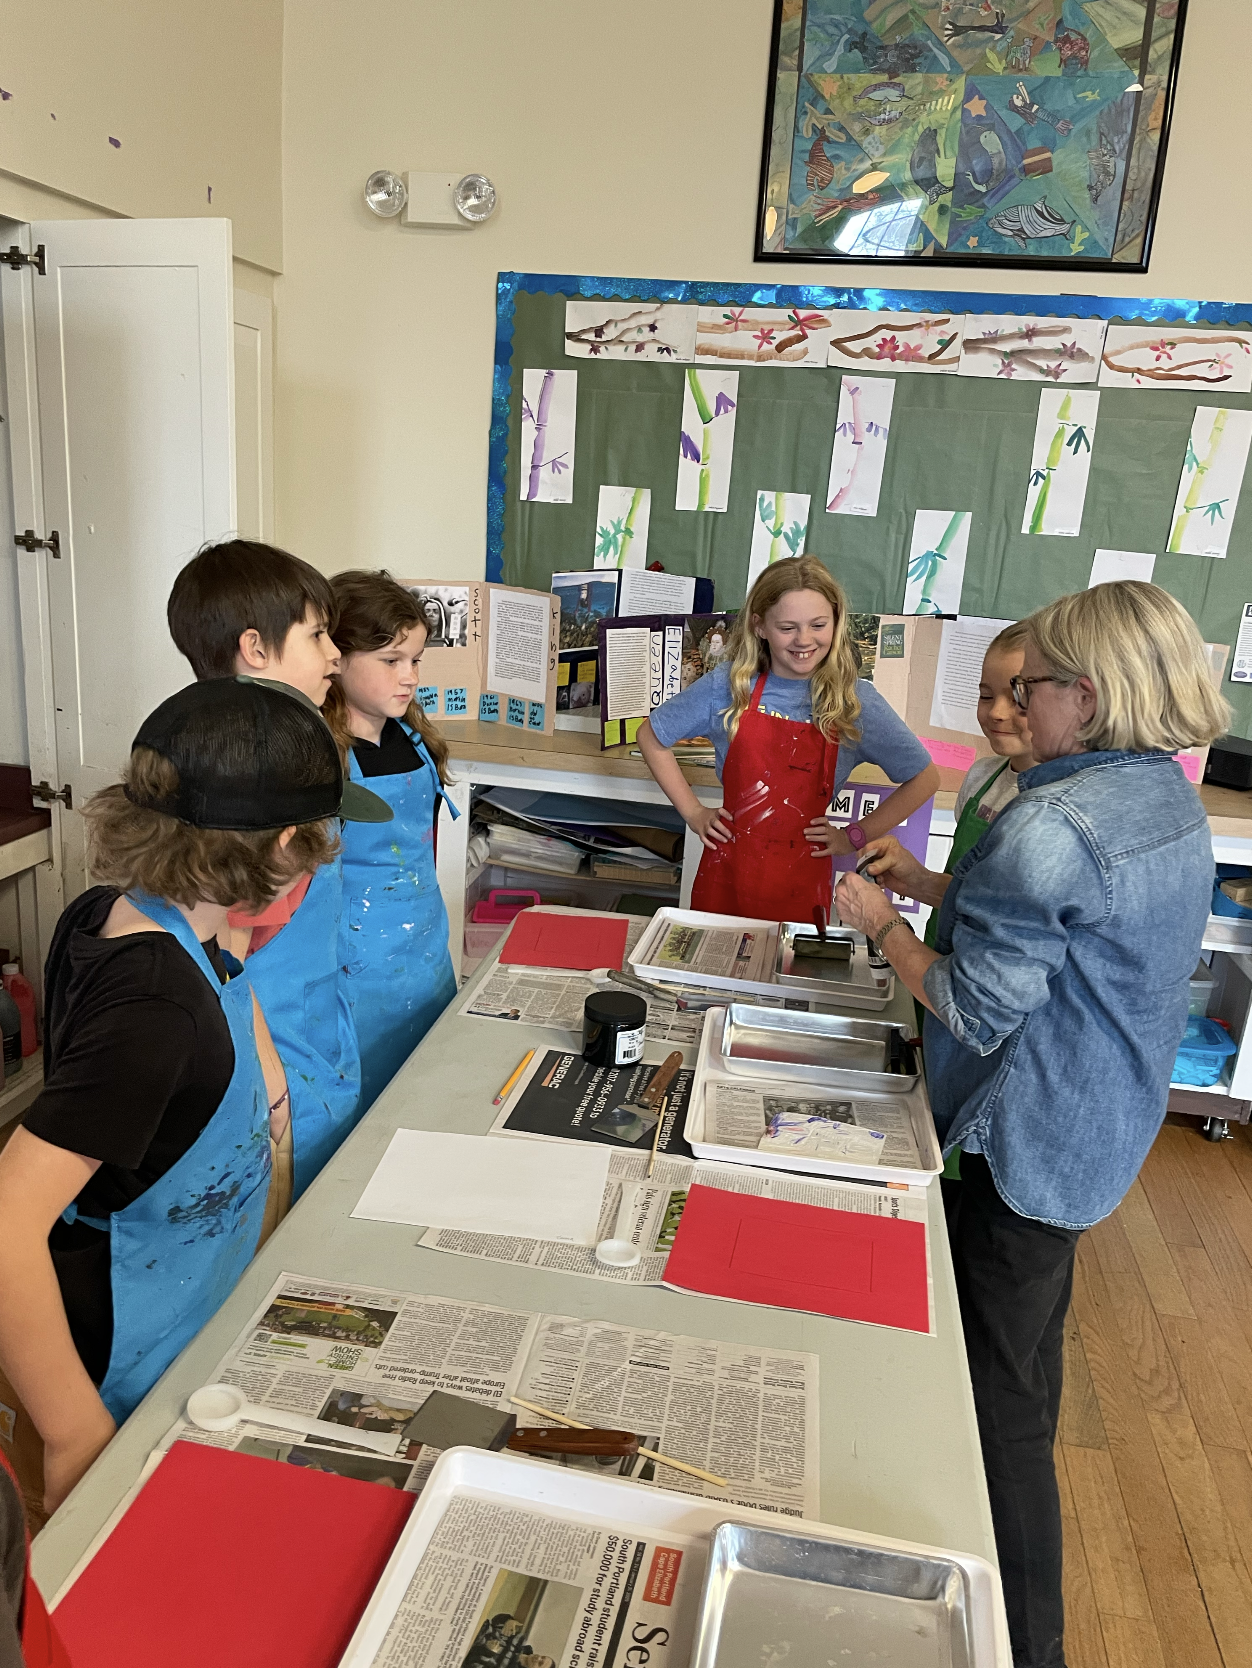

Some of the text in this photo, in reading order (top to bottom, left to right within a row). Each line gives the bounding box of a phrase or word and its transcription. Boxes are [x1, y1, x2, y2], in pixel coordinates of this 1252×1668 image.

[549, 1055, 575, 1089] GENERAC
[679, 1071, 694, 1081] It's
[586, 1082, 598, 1095] your
[592, 1071, 619, 1112] 207-956-0933
[675, 1080, 687, 1092] not
[580, 1094, 594, 1107] free
[671, 1091, 687, 1106] just
[571, 1106, 586, 1126] quote!
[656, 1111, 678, 1150] generator.
[330, 1345, 363, 1356] SHOW
[327, 1353, 360, 1362] ENERGY
[334, 1358, 357, 1366] HOME
[326, 1363, 354, 1372] GREEN
[373, 1363, 506, 1389] Europe afloat after Trump-ordered cuts
[382, 1373, 397, 1381] Free
[398, 1375, 418, 1385] Radio
[419, 1377, 436, 1387] keep
[445, 1382, 463, 1391] ways
[465, 1385, 492, 1396] debates
[493, 1389, 503, 1398] EU
[758, 1503, 778, 1513] rules
[780, 1507, 804, 1519] Judge
[600, 1534, 619, 1572] $50,000
[596, 1572, 608, 1587] for
[650, 1552, 668, 1598] Cape Elizabeth
[659, 1552, 678, 1602] South Portland
[584, 1587, 601, 1616] study
[586, 1538, 633, 1668] South Portland student rais
[574, 1616, 593, 1653] abroad
